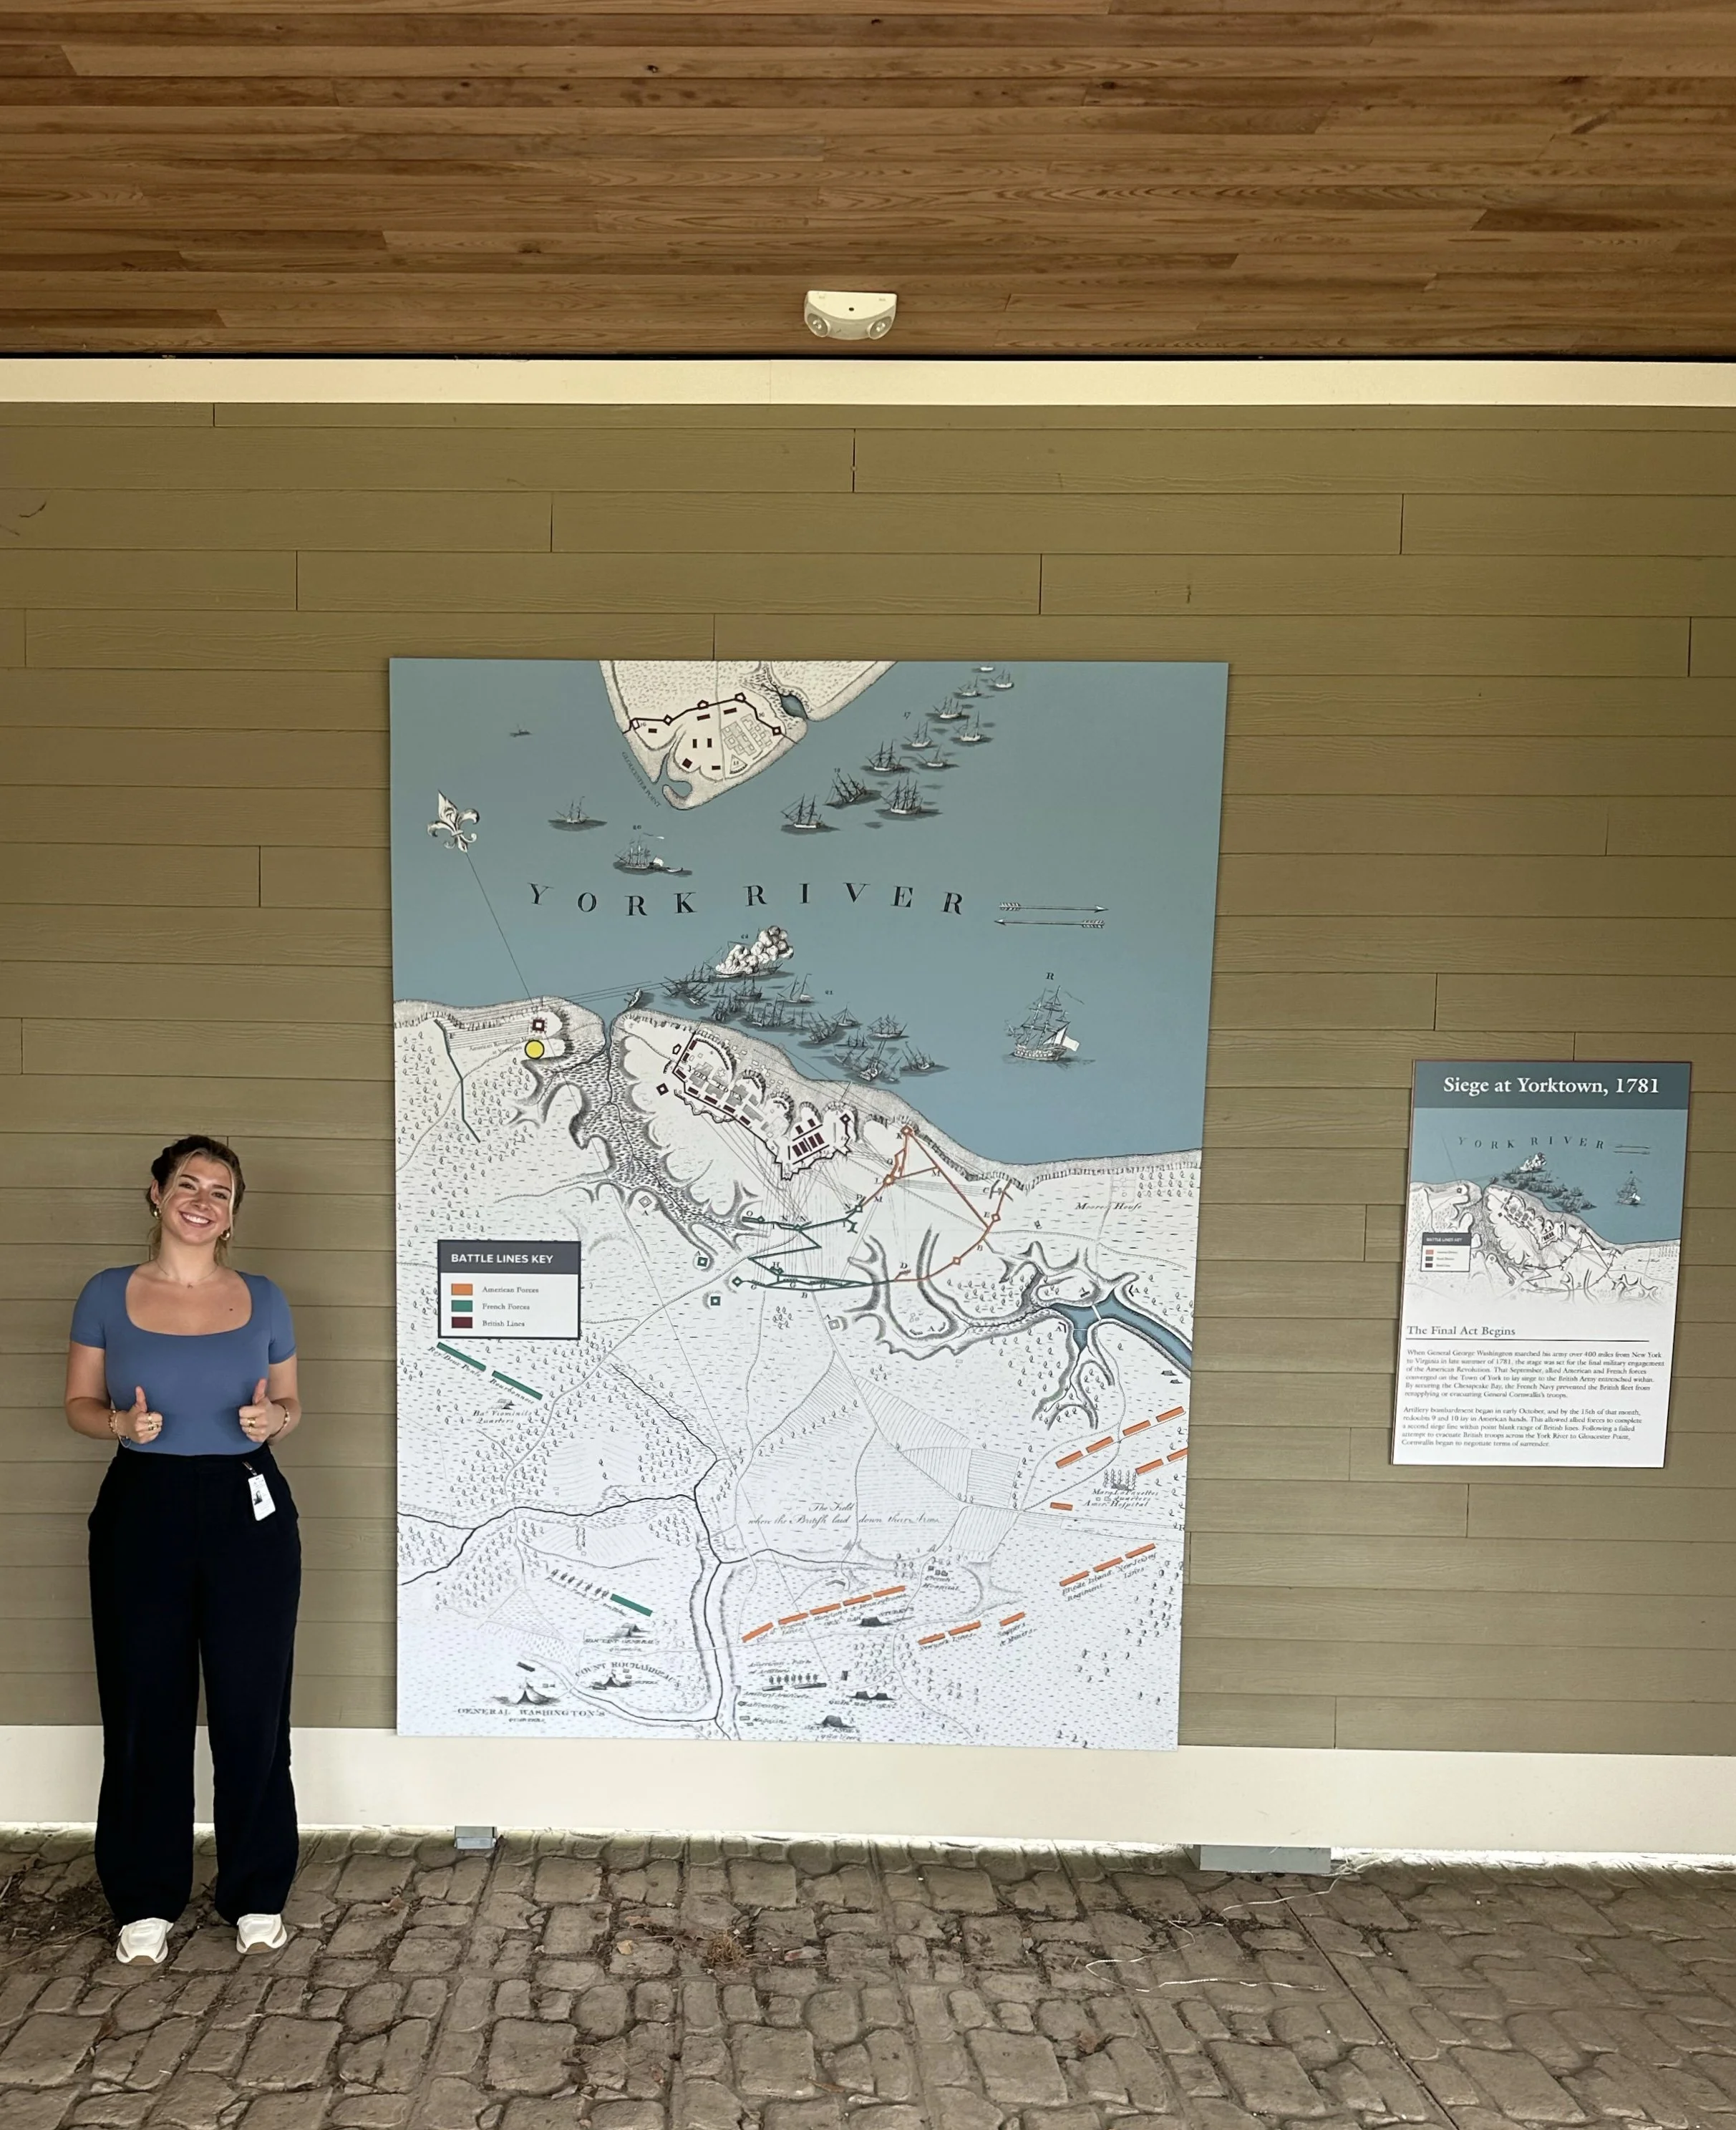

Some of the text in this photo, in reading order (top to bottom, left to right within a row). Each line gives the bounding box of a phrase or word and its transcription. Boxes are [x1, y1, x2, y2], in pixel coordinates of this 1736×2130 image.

[528, 881, 963, 917] YORK RIVER
[1443, 1077, 1659, 1096] Siege at Yorktown, 1781
[1458, 1135, 1604, 1150] YORK RIVER
[451, 1254, 554, 1264] BATTLE LINES KEY
[1407, 1326, 1516, 1338] The Final Act Begins
[1477, 1350, 1513, 1358] Washington
[1405, 1373, 1437, 1382] converged
[1484, 1431, 1505, 1440] troops
[808, 1501, 855, 1511] The Field
[831, 1514, 849, 1524] laid
[858, 1514, 882, 1523] down
[575, 1662, 607, 1678] COUNT
